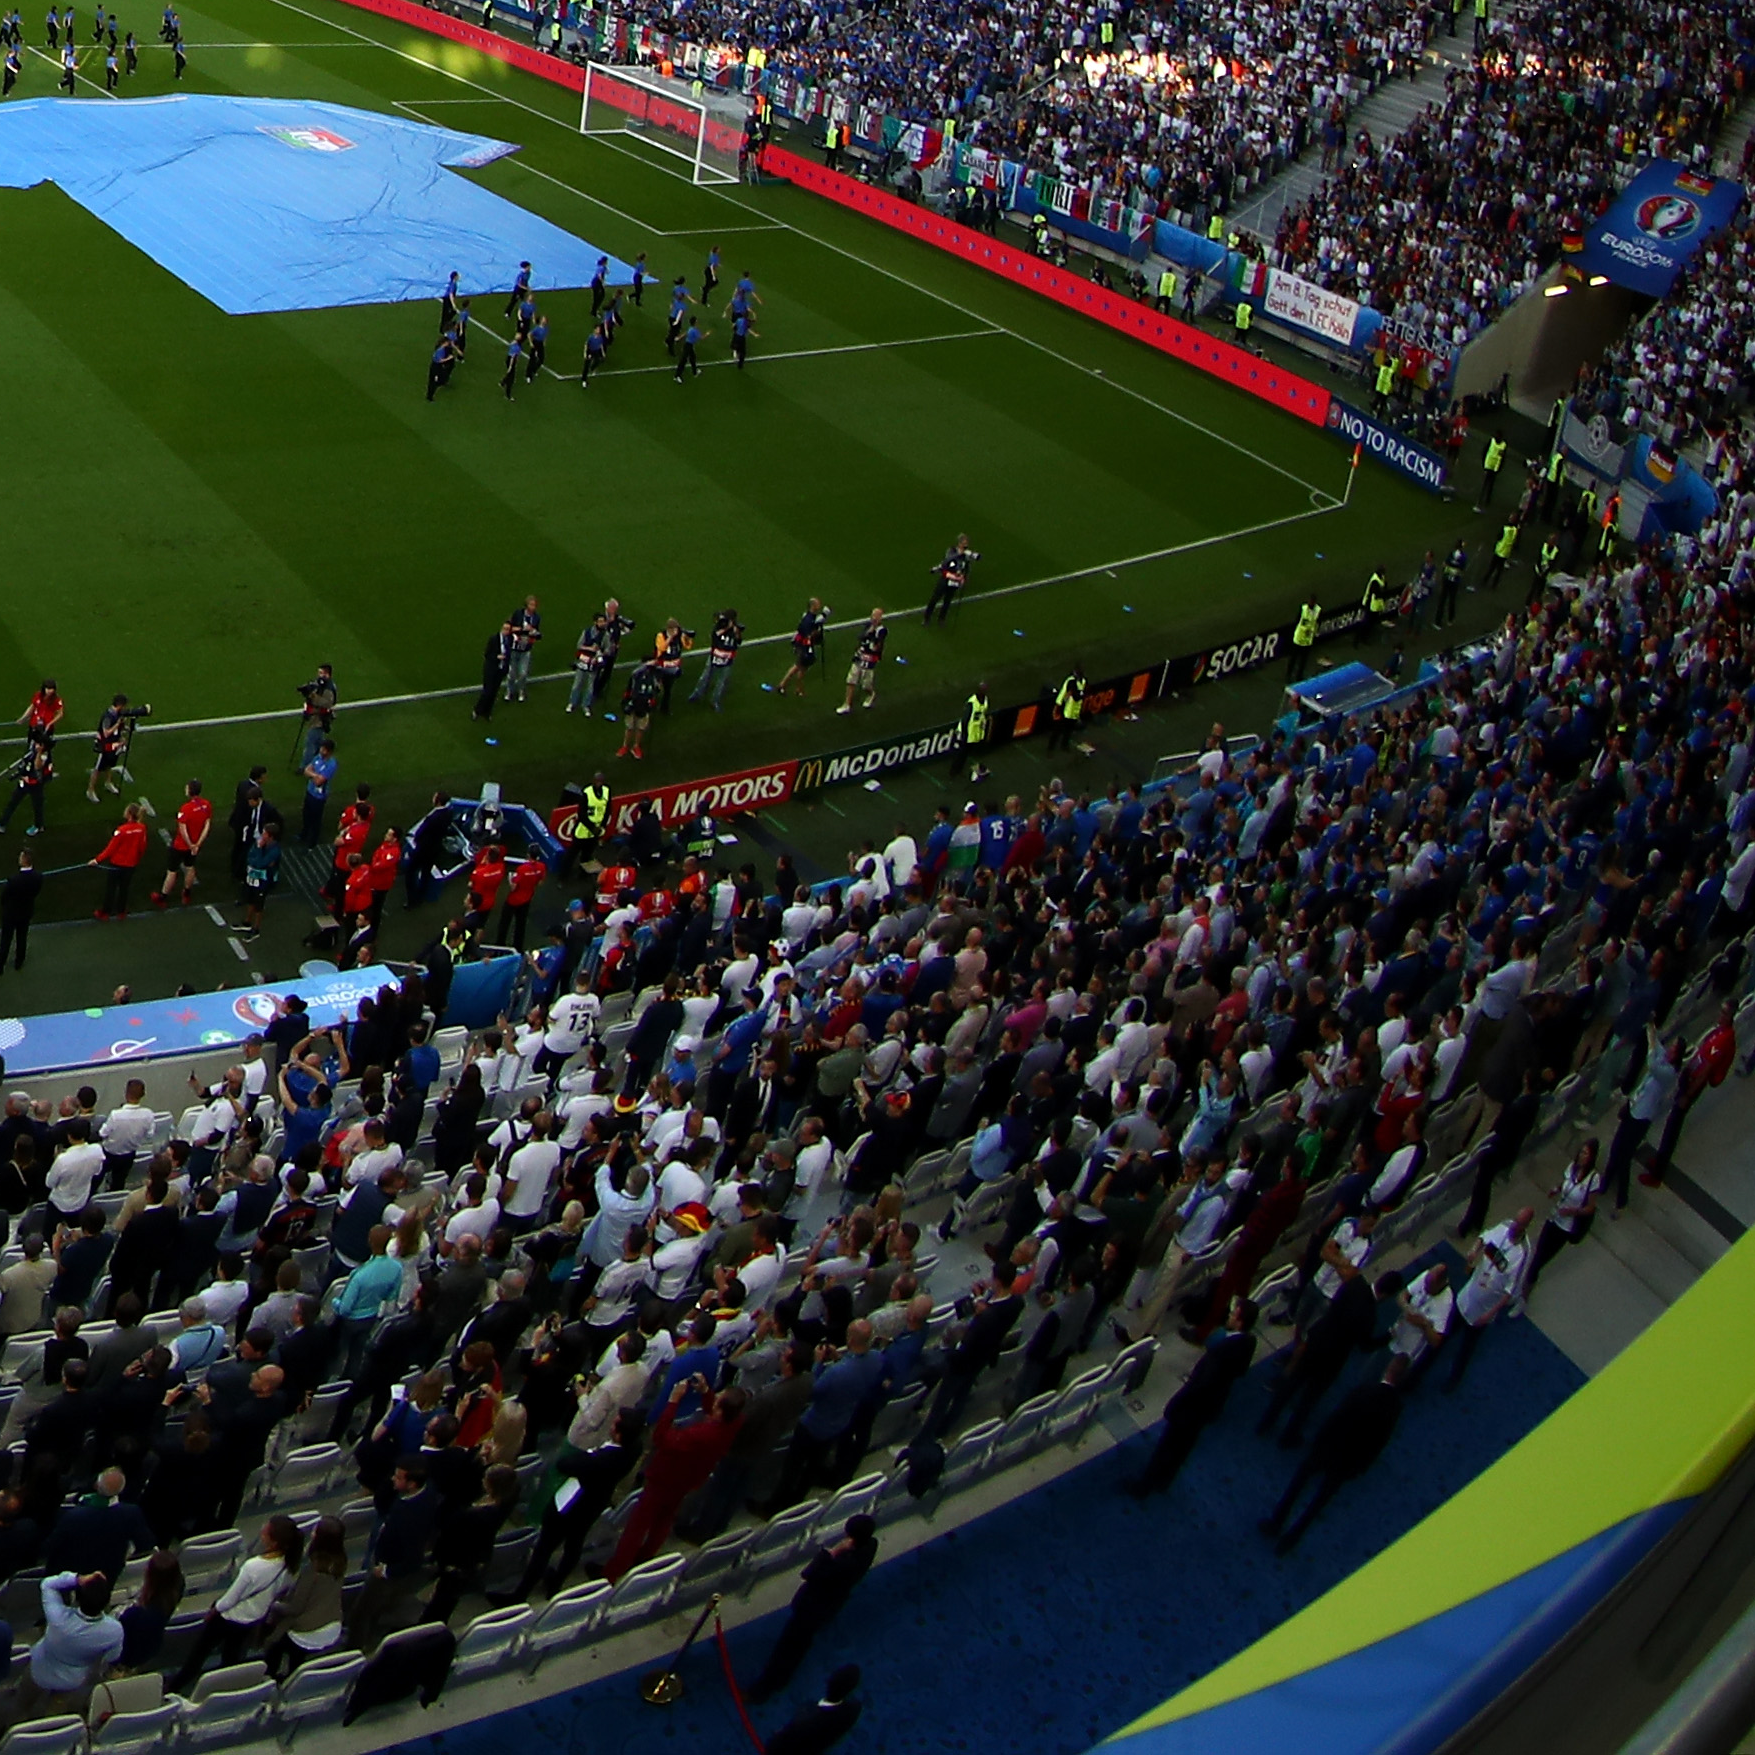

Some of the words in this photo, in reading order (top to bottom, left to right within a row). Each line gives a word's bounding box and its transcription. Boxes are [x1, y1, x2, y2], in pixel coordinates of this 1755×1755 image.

[1600, 231, 1675, 269] EURO2016
[1266, 294, 1288, 315] Gott
[1289, 304, 1306, 319] den
[1274, 274, 1291, 293] Am
[1303, 287, 1320, 308] Tag
[1339, 410, 1364, 440] NO
[1365, 424, 1386, 452] TO
[1386, 435, 1442, 487] RACISM
[1205, 631, 1280, 679] SOCAR
[671, 770, 788, 817] MOTORS
[566, 1012, 589, 1032] 13
